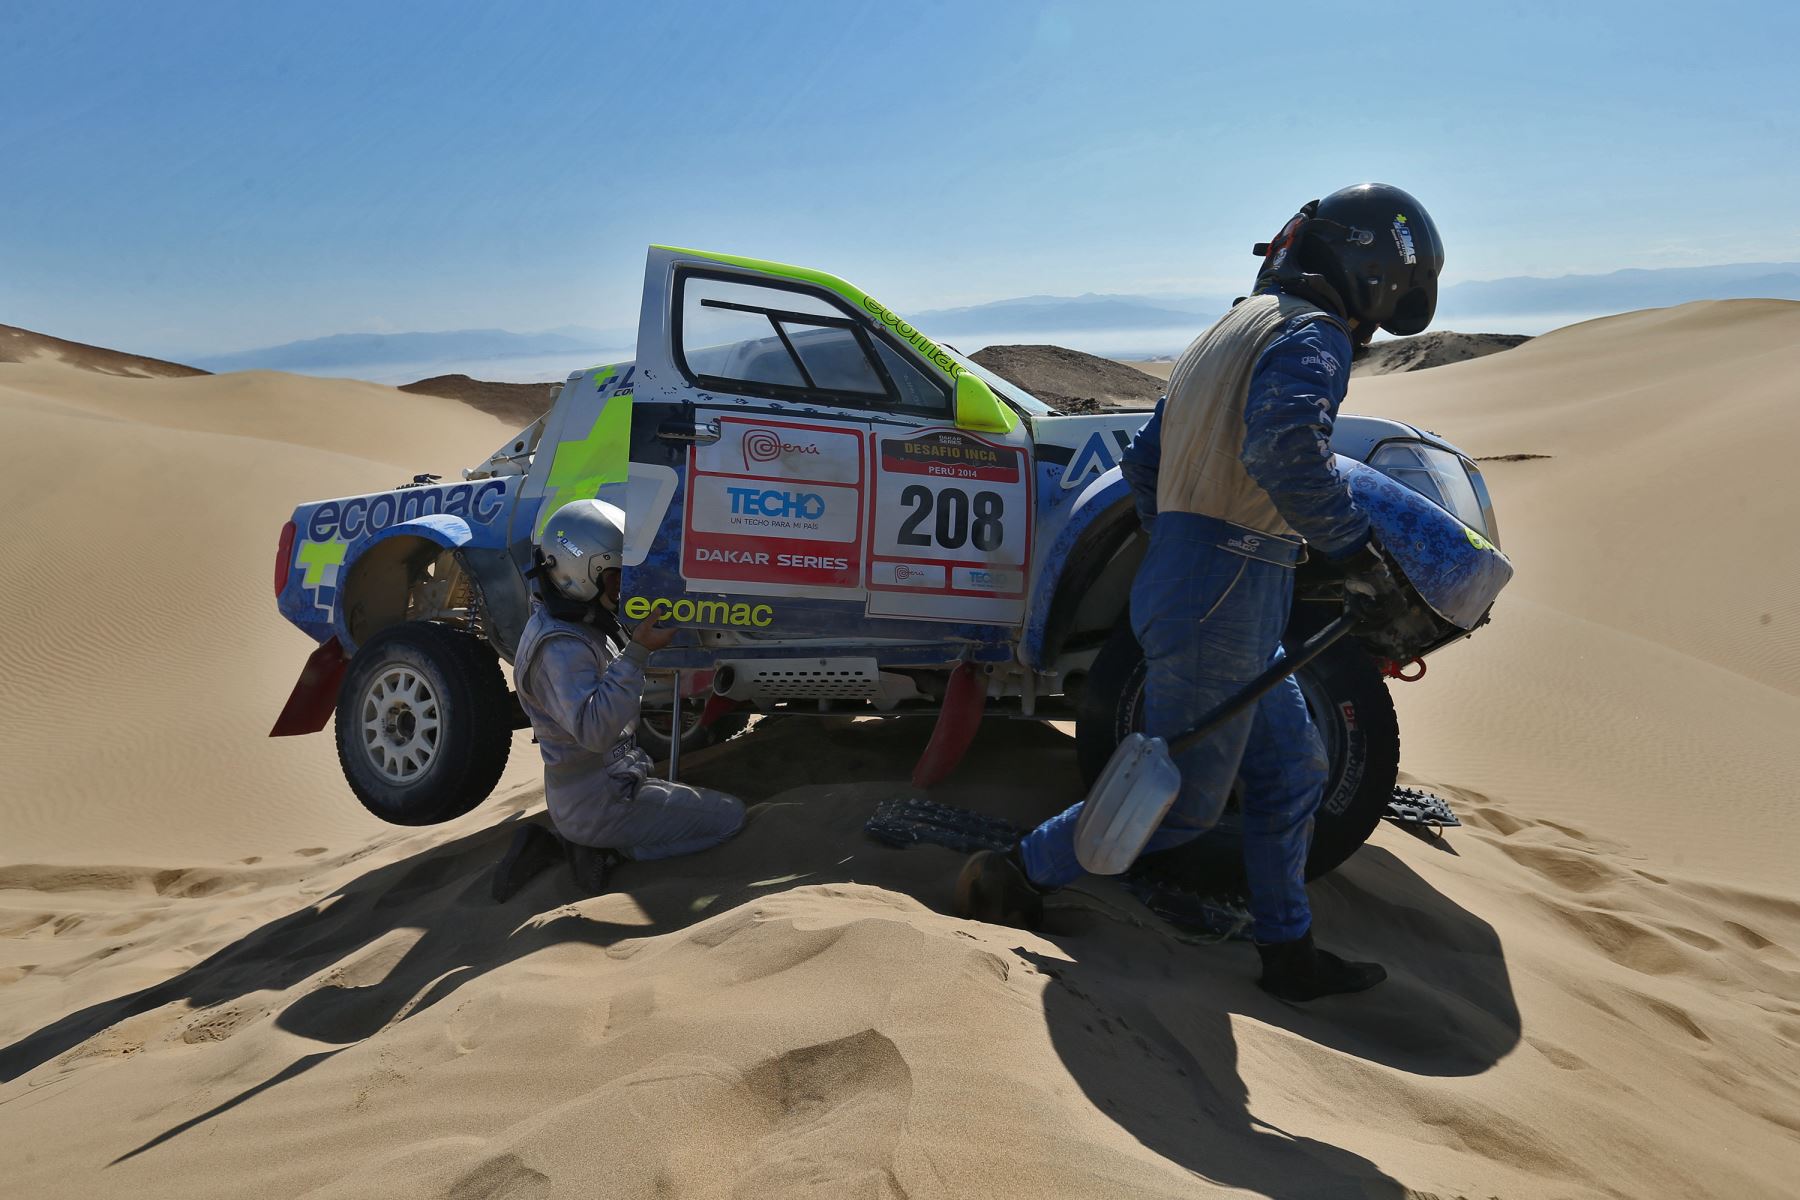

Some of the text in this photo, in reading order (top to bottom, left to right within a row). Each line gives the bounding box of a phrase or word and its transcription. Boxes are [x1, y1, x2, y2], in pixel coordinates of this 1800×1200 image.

[964, 448, 997, 461] INCA
[928, 465, 977, 478] PERÚ 2014
[309, 480, 504, 543] ecomac
[727, 487, 826, 520] TECHO
[730, 517, 742, 525] UN
[744, 518, 770, 527] TECHO
[771, 520, 791, 529] PARA
[897, 484, 1004, 552] 208
[695, 548, 849, 571] DAKAR SERIES
[624, 596, 773, 627] ecomac
